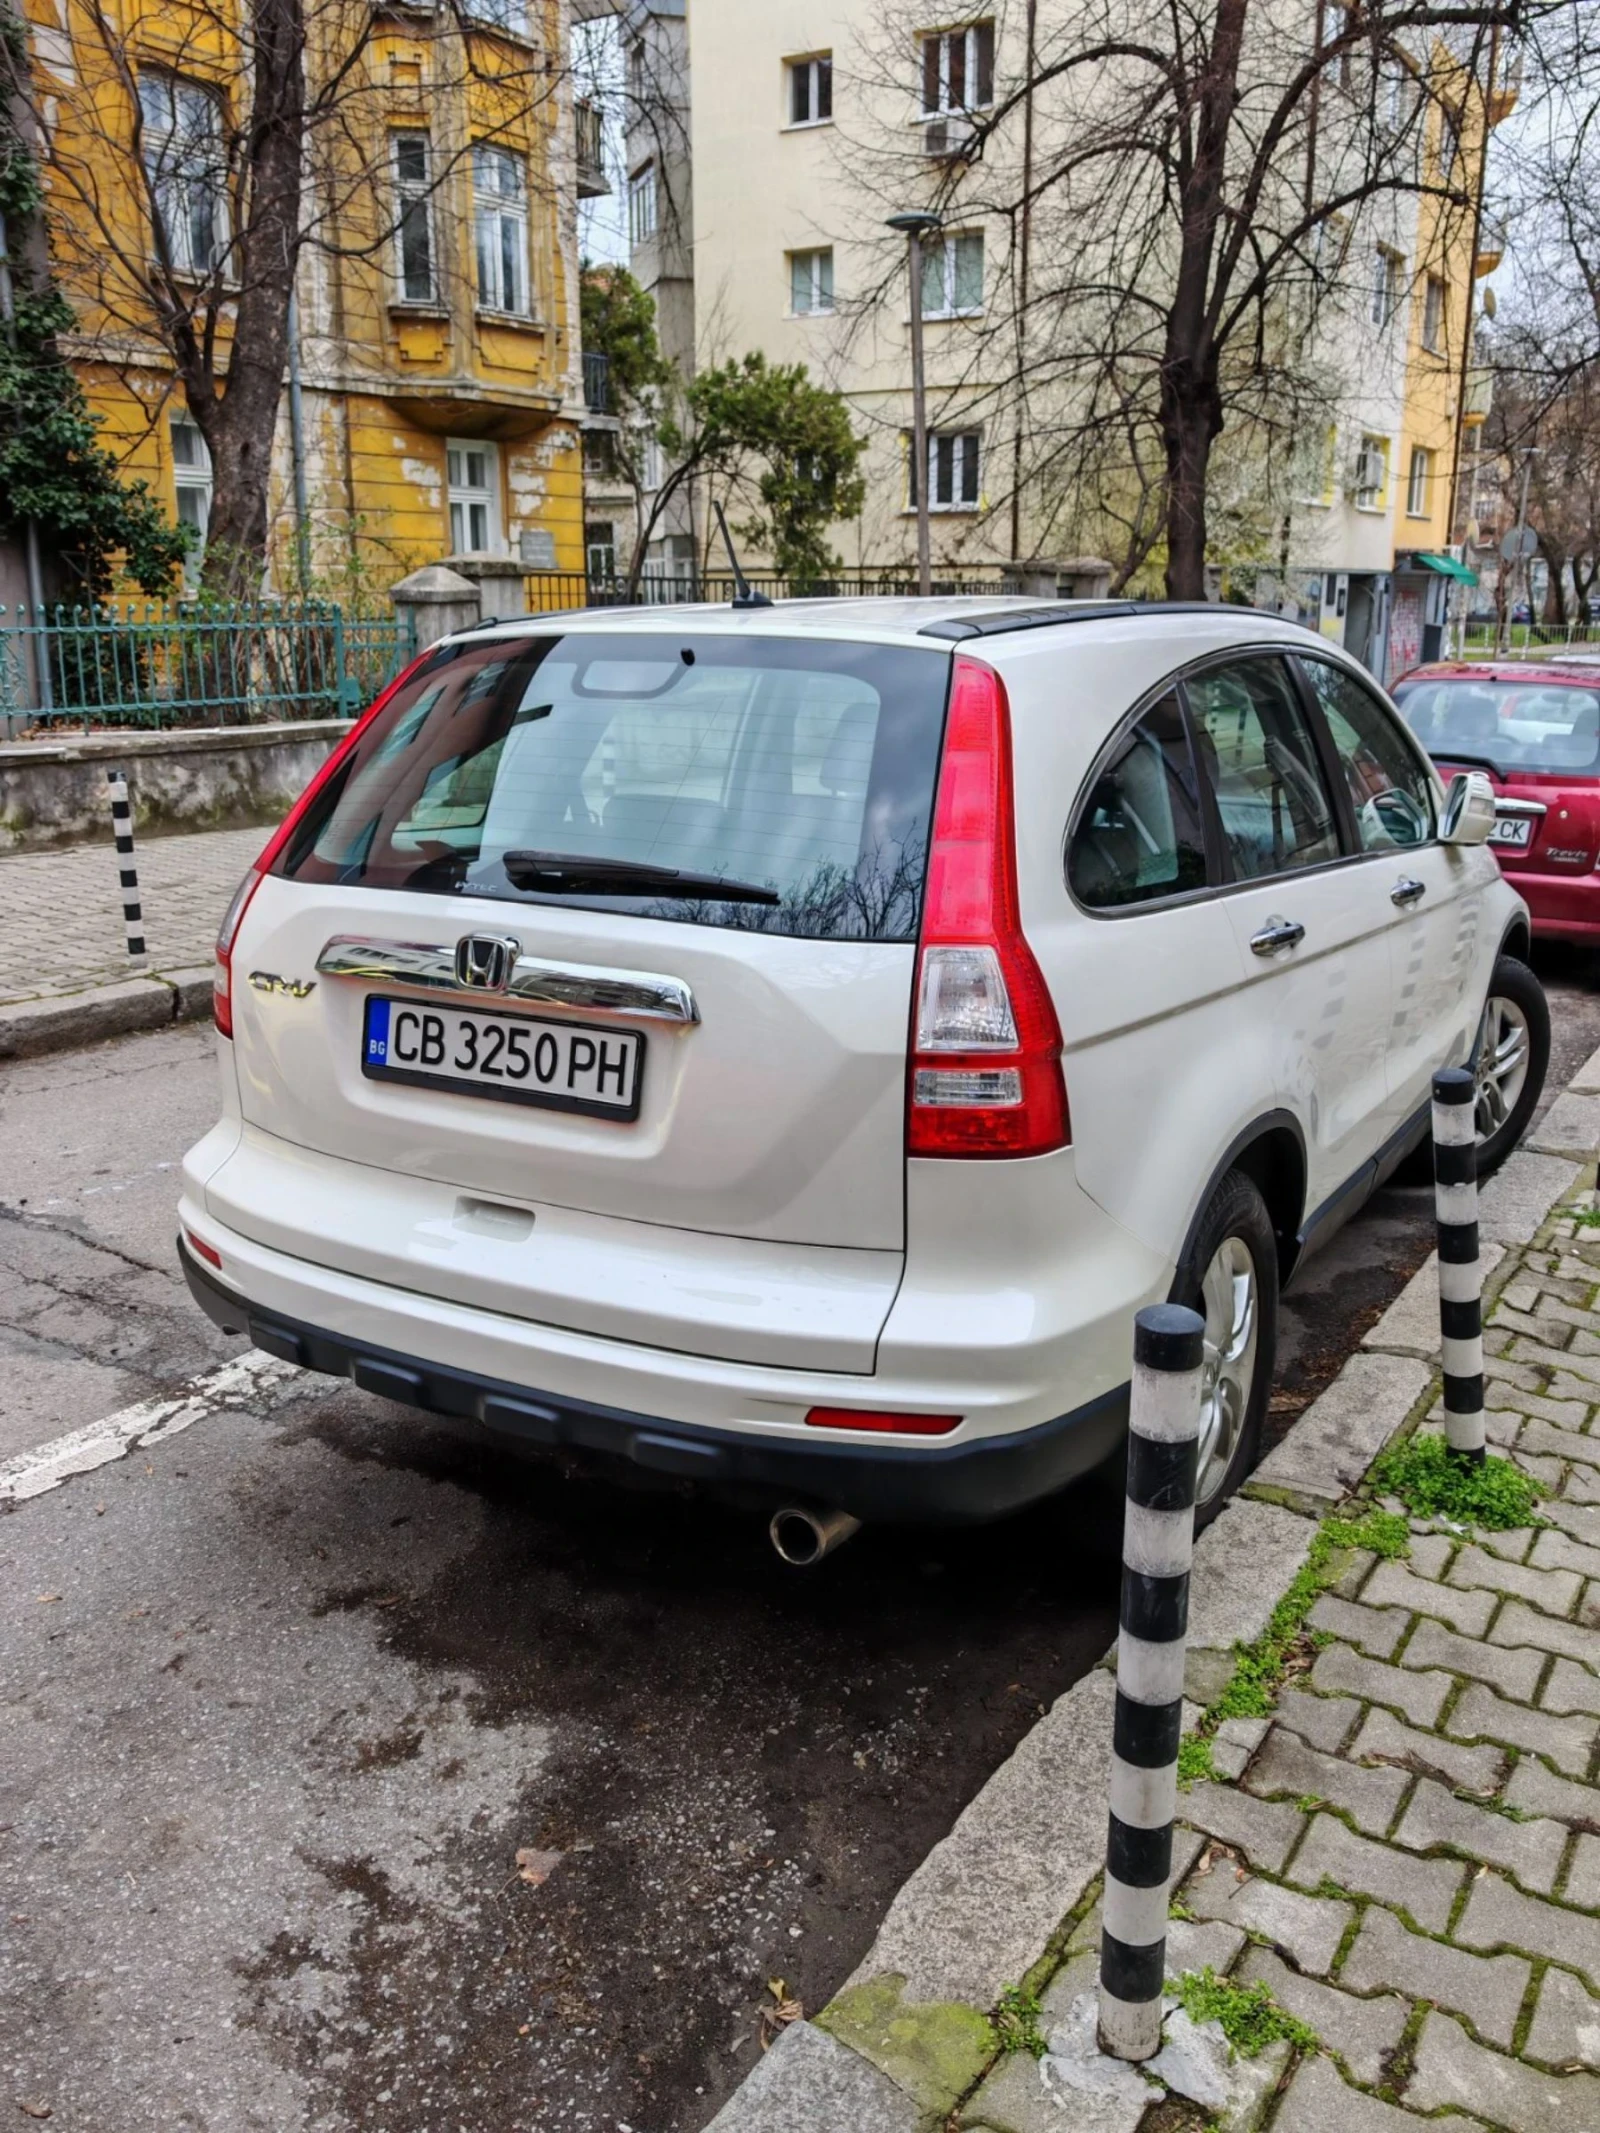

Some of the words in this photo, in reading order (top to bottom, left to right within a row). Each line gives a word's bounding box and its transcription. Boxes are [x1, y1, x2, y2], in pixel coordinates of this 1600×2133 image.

[1500, 821, 1525, 840] CK
[248, 969, 317, 999] CR-V
[369, 1039, 386, 1056] BG
[394, 1011, 445, 1066] CB
[454, 1020, 559, 1084] 3250
[567, 1036, 628, 1097] PH
